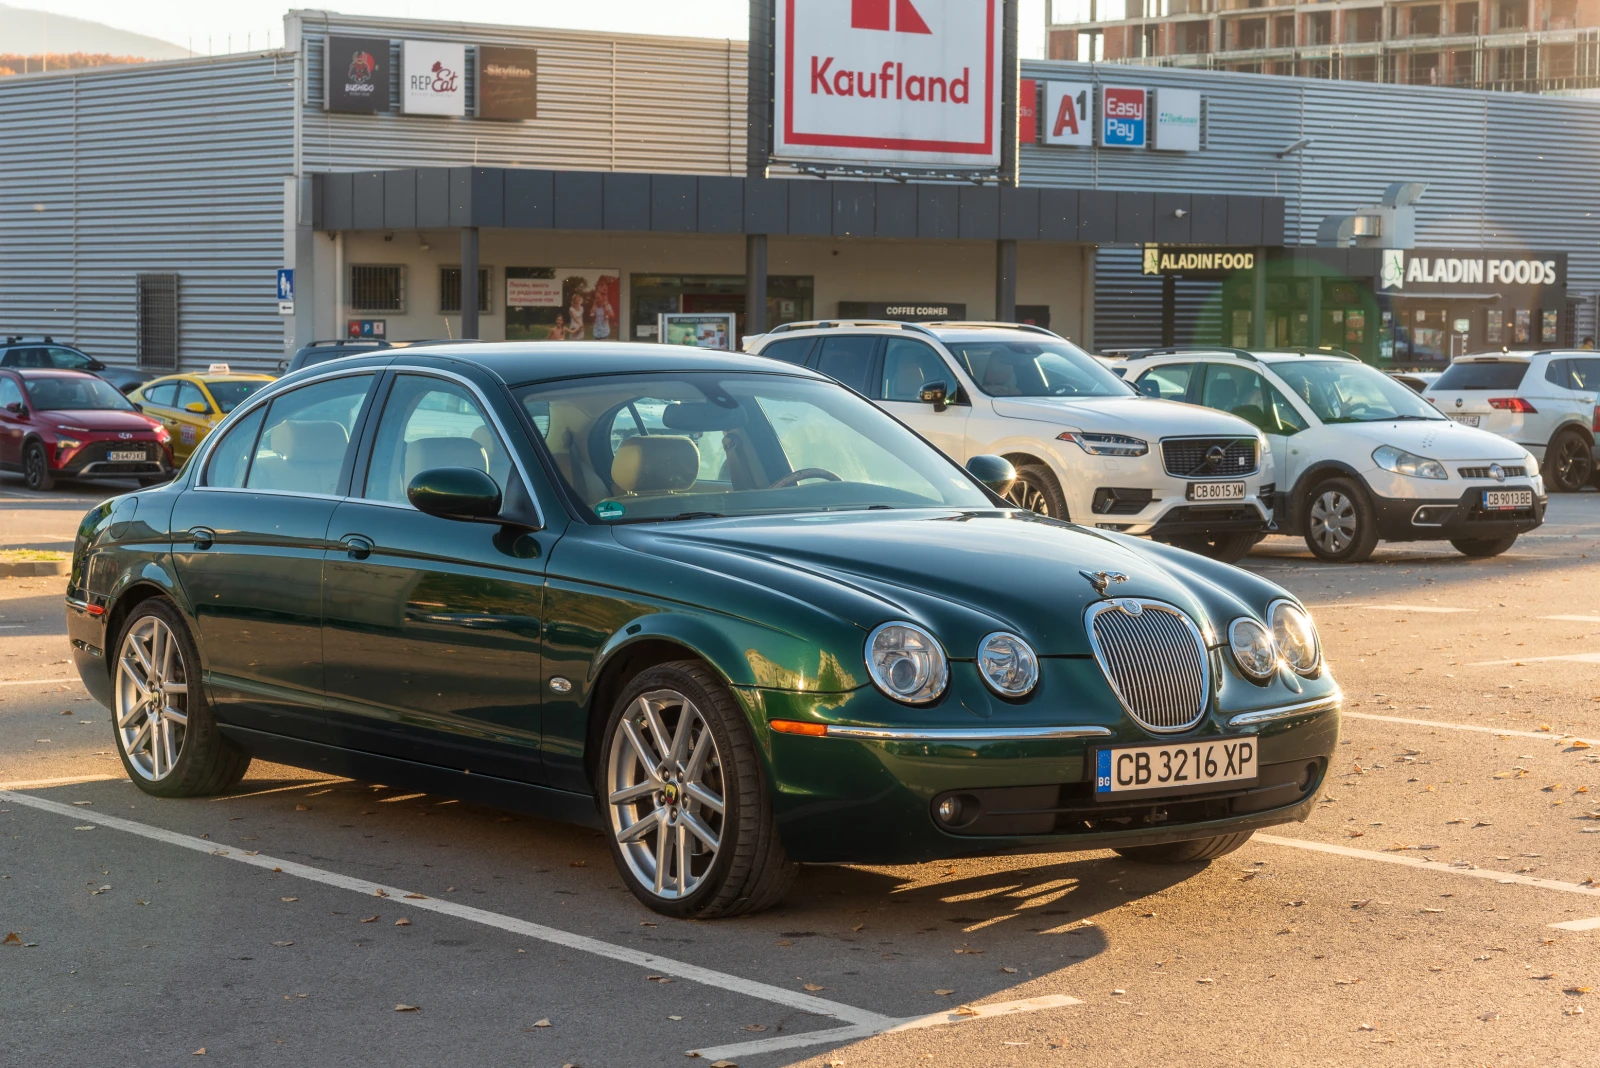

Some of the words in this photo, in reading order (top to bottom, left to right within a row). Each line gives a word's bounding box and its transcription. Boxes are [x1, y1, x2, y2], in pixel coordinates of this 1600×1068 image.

[345, 84, 374, 92] BUSHIDO
[811, 56, 969, 104] Kaufland
[1052, 90, 1087, 136] A1
[1106, 97, 1142, 120] Easy
[1106, 120, 1134, 141] Pay
[1160, 253, 1212, 269] ALADIN
[1406, 257, 1483, 283] ALADIN
[1486, 260, 1556, 285] FOODS
[886, 306, 914, 315] COFFEE
[916, 306, 948, 316] CORNER
[364, 324, 370, 332] P
[1196, 486, 1208, 497] CB
[1210, 485, 1231, 497] 8015
[1232, 484, 1243, 496] XM
[1488, 493, 1499, 505] CB
[1500, 493, 1519, 504] 9013
[1520, 493, 1530, 504] BE
[1116, 752, 1152, 786] CB
[1158, 746, 1218, 781] 3216
[1224, 743, 1252, 776] XP
[1098, 776, 1110, 787] BG
